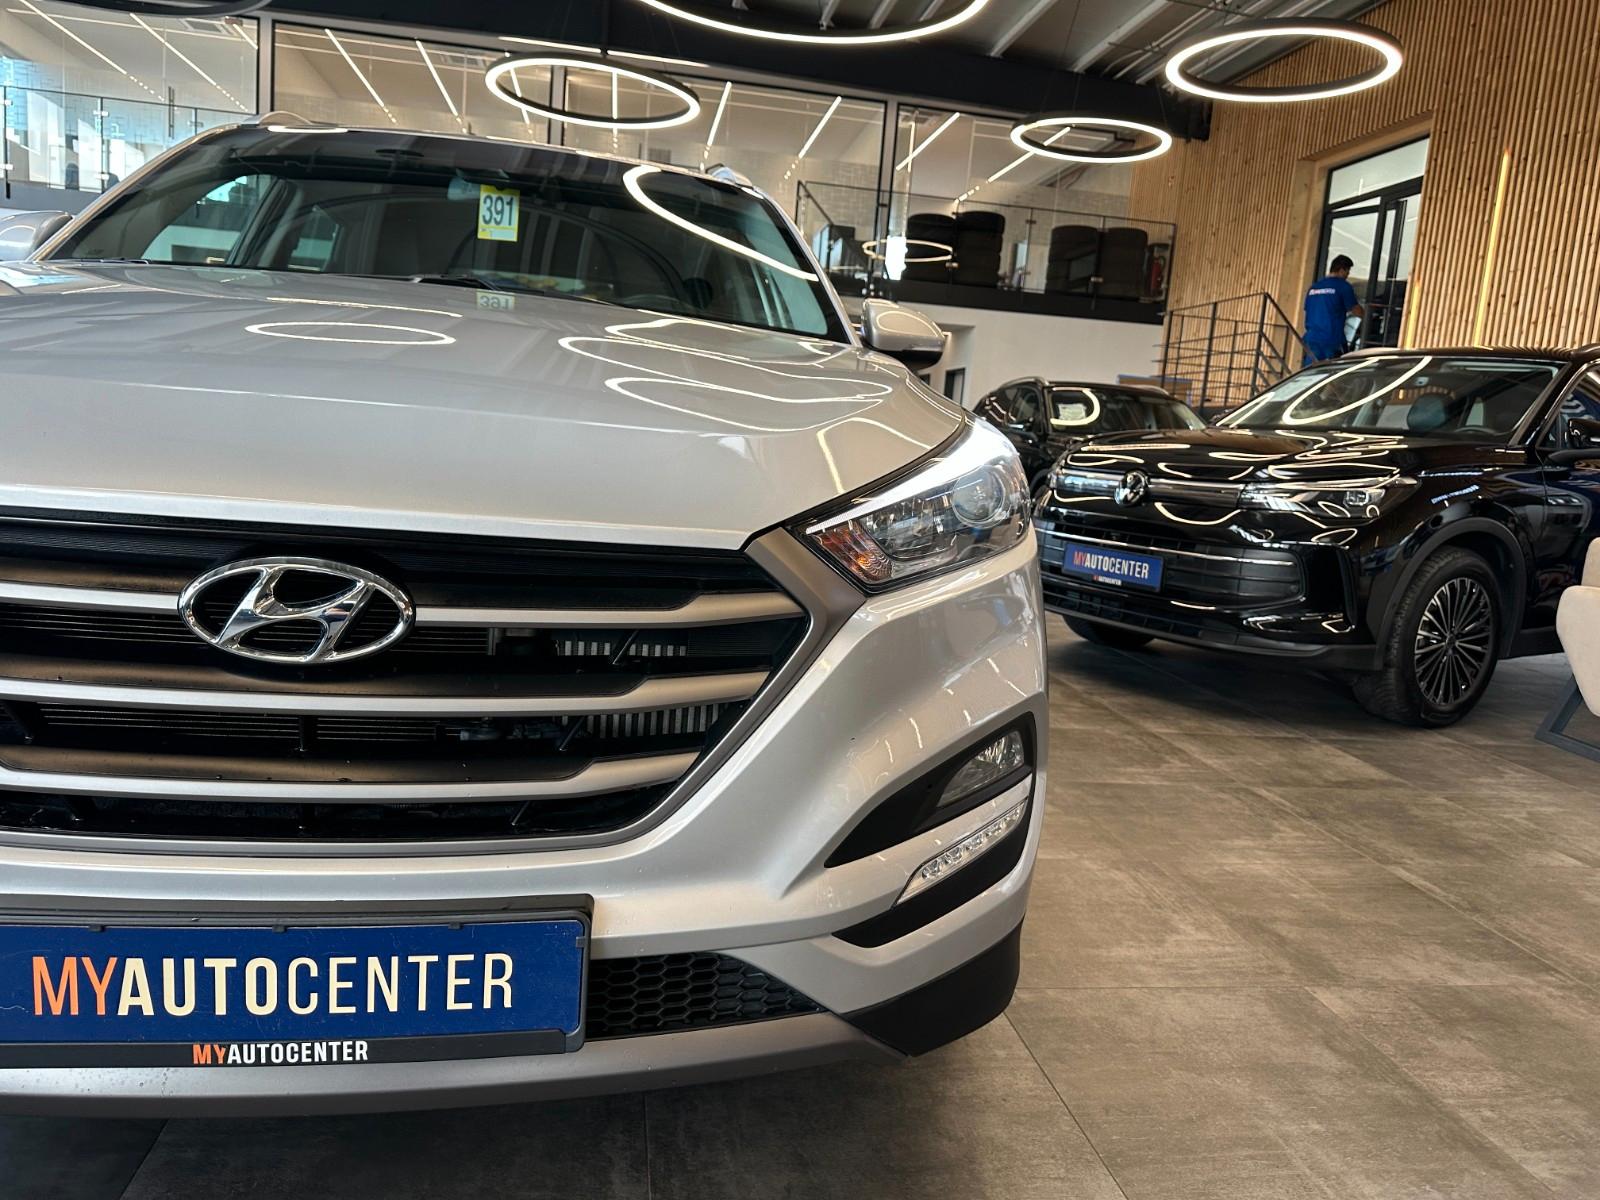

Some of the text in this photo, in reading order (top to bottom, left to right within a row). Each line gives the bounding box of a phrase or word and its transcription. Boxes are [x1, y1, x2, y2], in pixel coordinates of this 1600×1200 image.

[482, 194, 514, 226] 391
[1073, 551, 1149, 579] MYAUTOCENTER
[32, 953, 514, 1017] MYAUTOCENTER
[192, 1040, 369, 1064] MYAUTOCENTER
